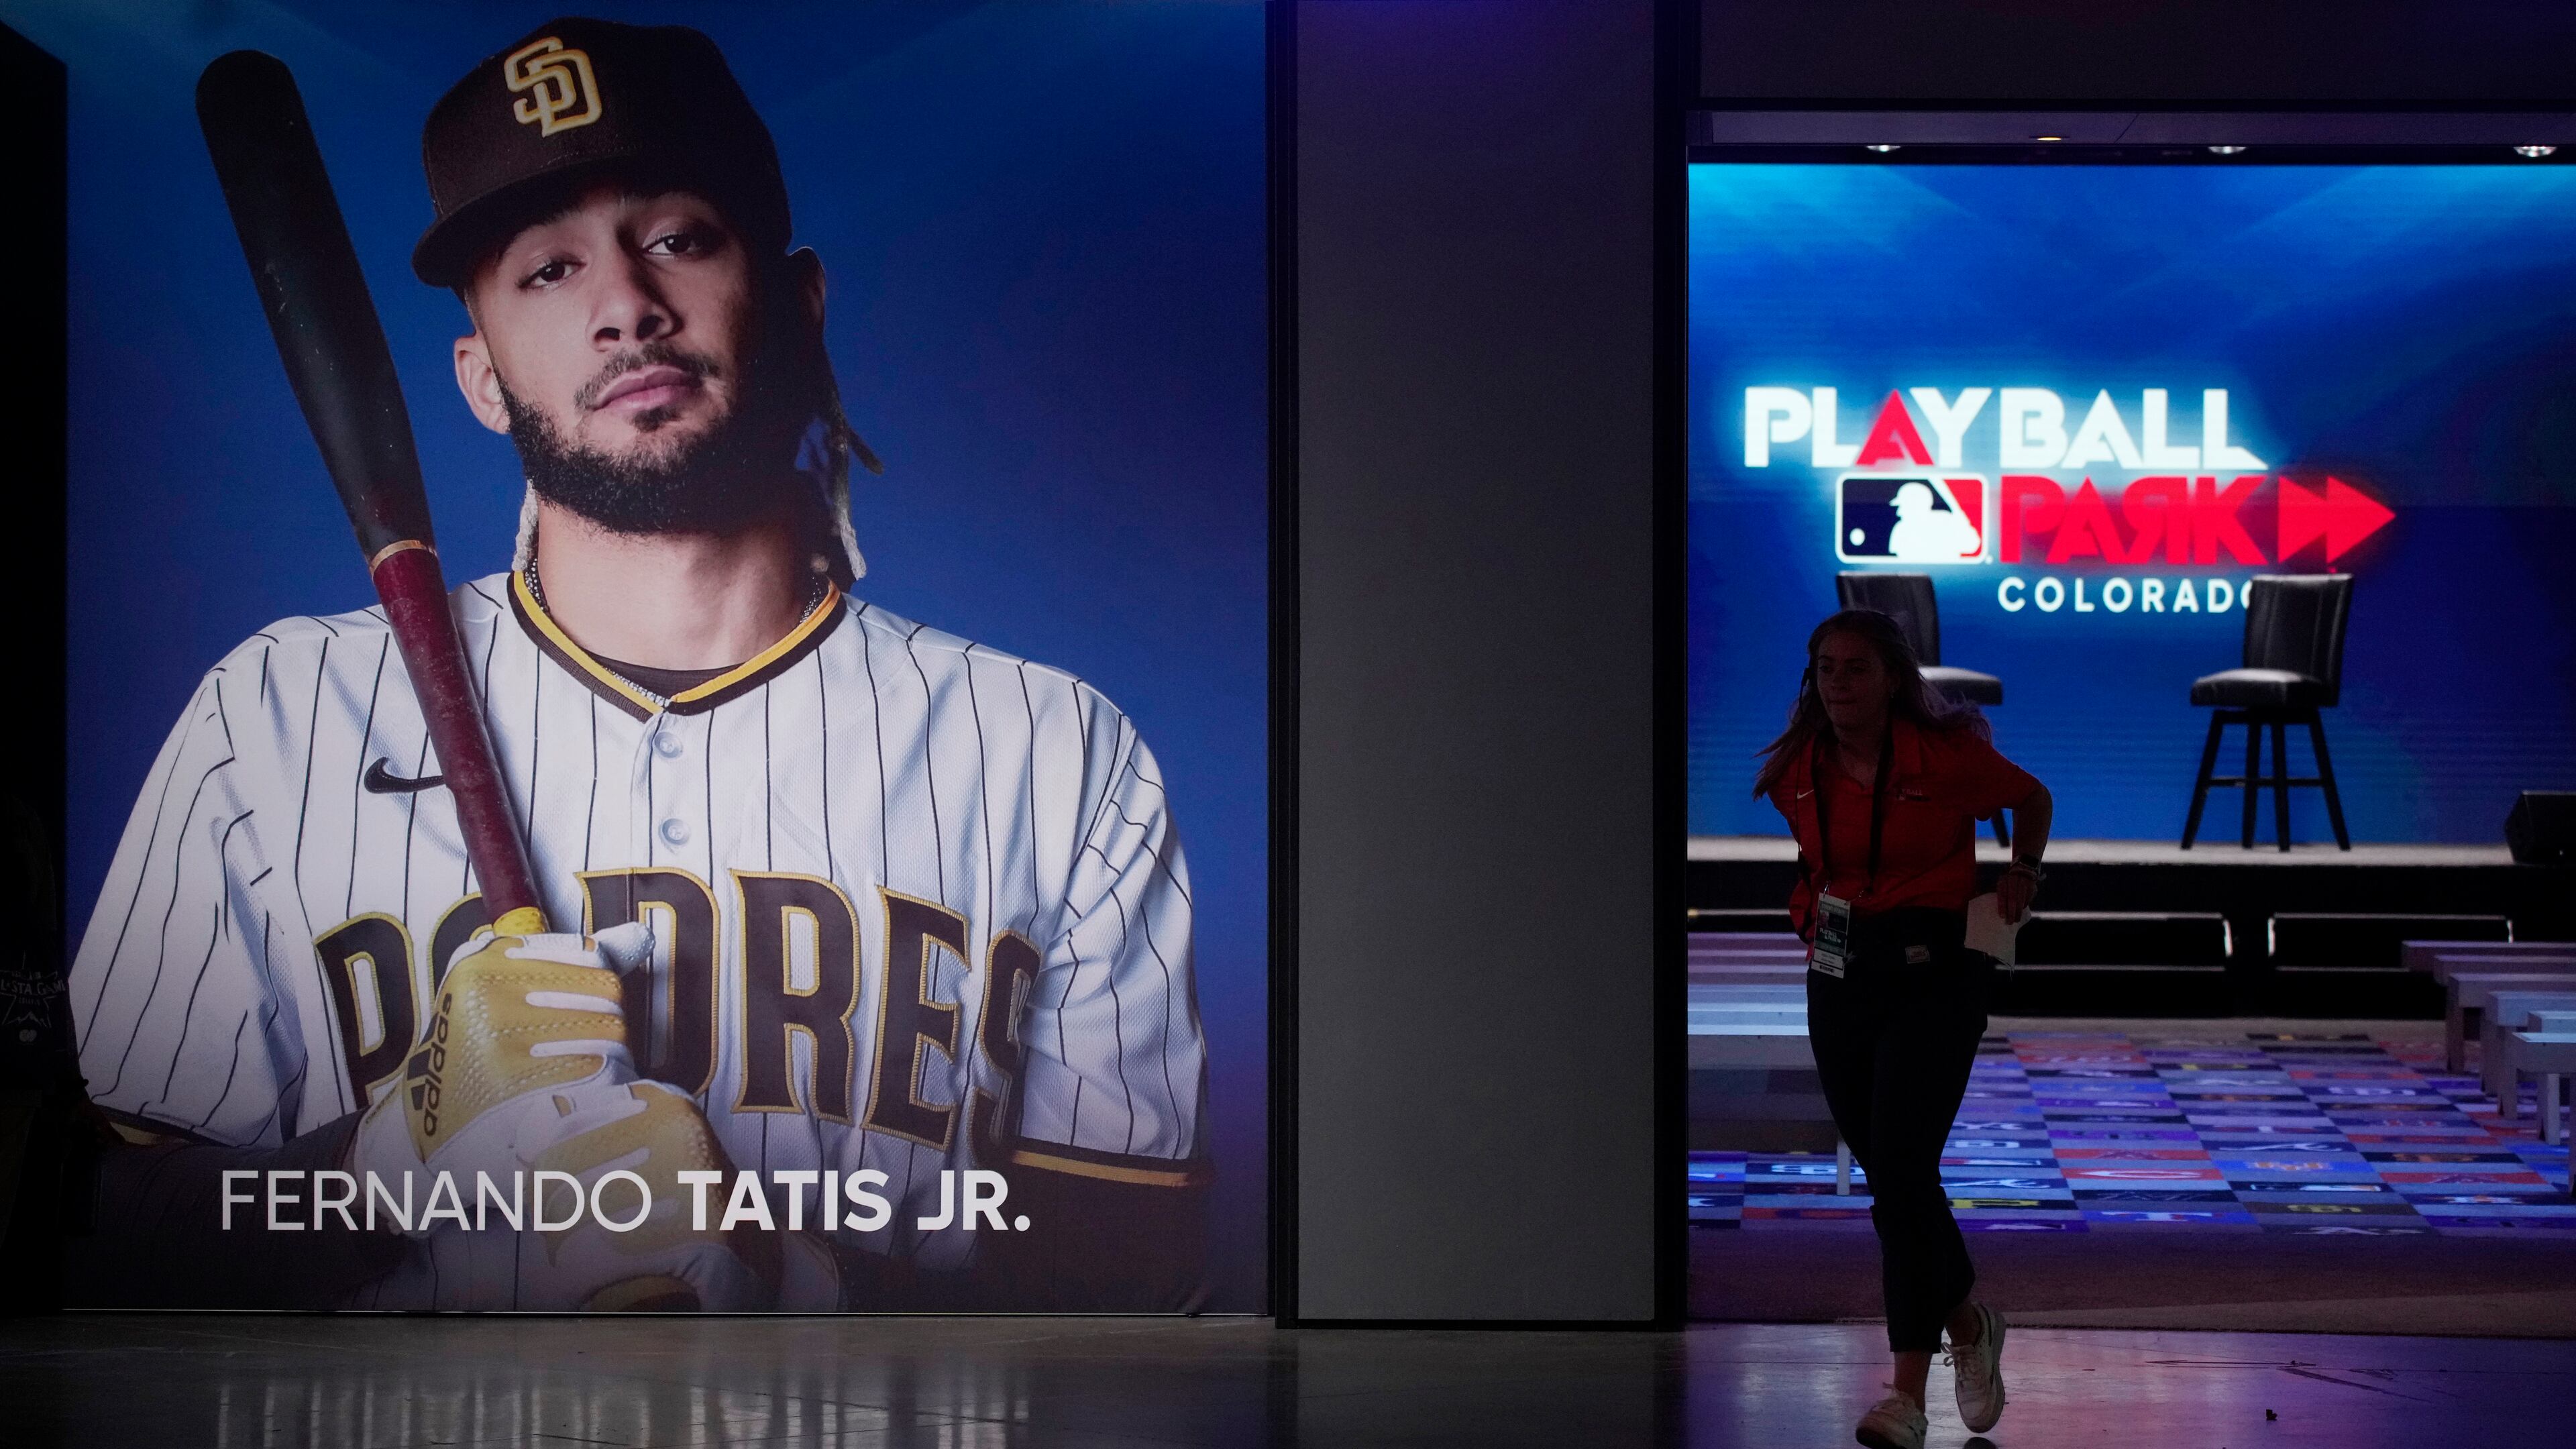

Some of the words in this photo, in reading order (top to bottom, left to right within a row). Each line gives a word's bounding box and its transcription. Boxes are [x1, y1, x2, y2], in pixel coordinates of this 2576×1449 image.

[504, 36, 602, 138] SD
[423, 992, 453, 1136] adidas
[223, 1169, 652, 1232] FERNANDO
[678, 1169, 892, 1232] TATIS
[917, 1169, 1030, 1232] JR.
